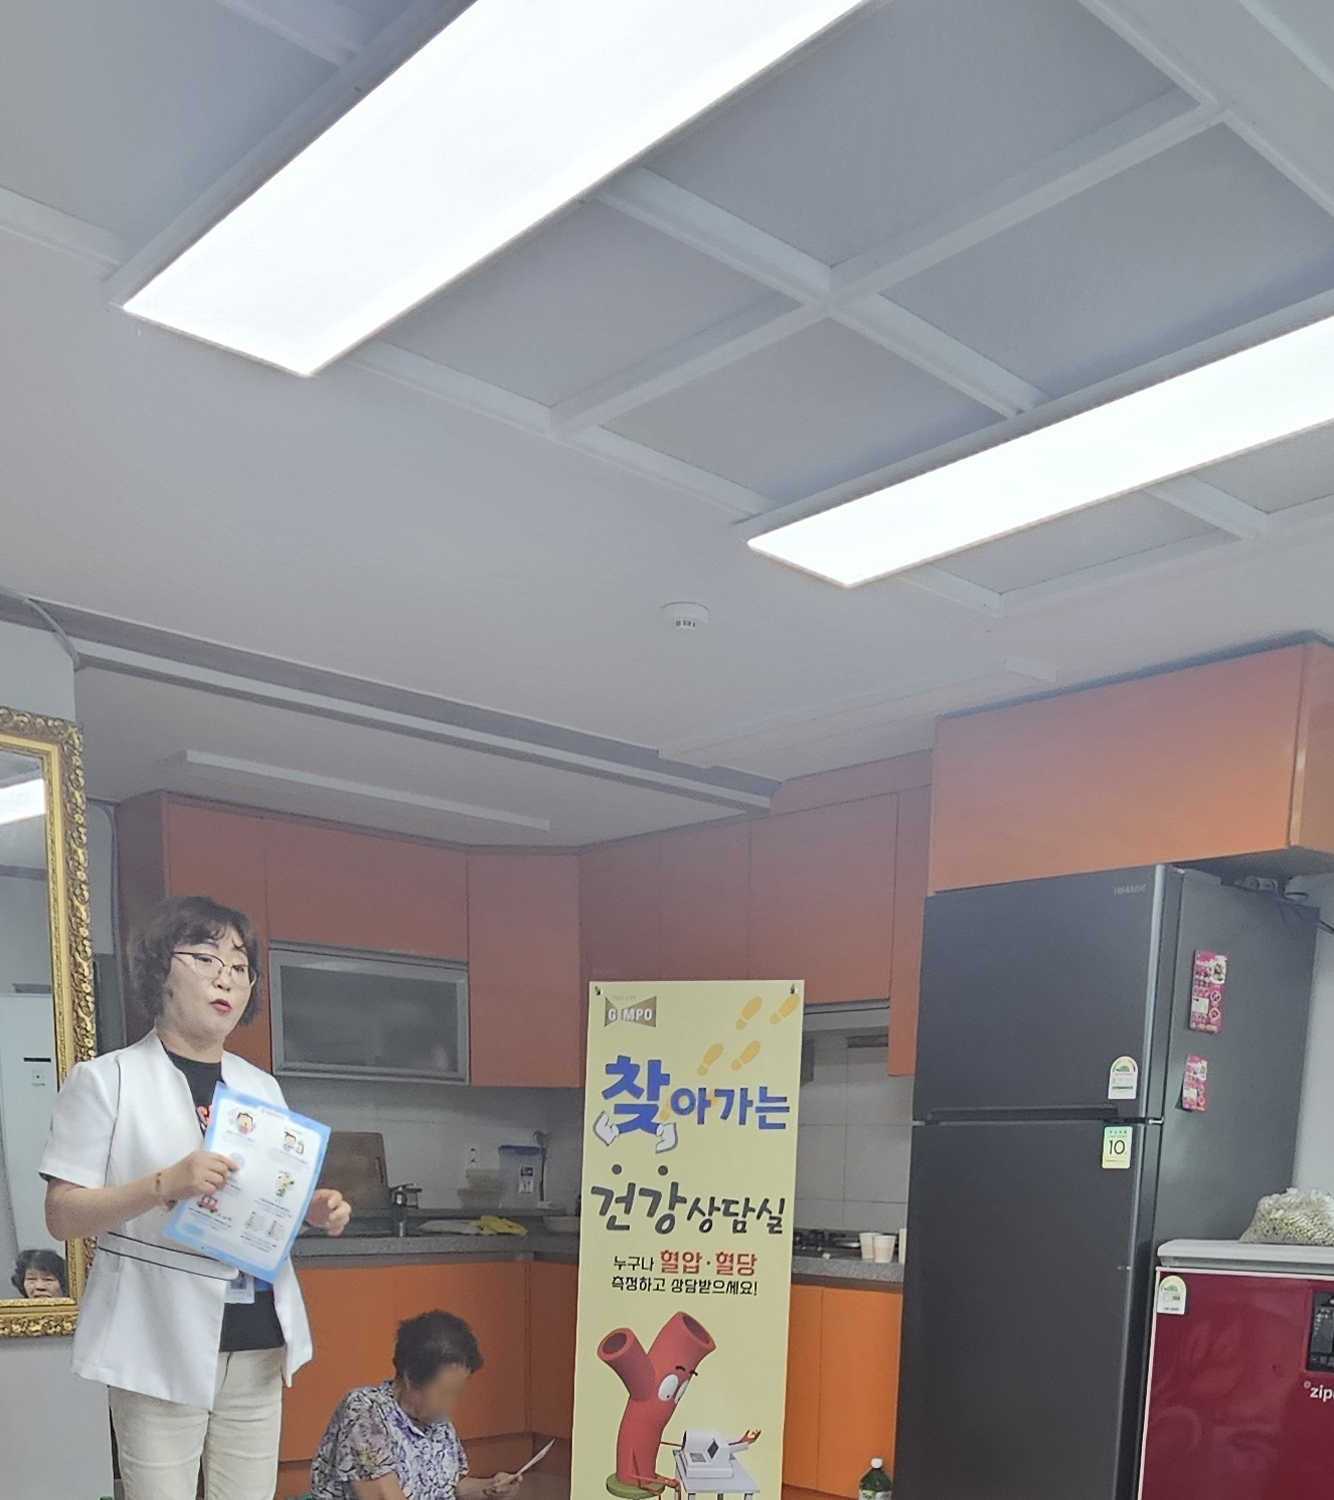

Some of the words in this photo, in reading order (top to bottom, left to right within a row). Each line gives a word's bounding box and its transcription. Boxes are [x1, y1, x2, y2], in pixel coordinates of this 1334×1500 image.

[601, 1055, 790, 1135] 찾아가는
[1109, 1139, 1126, 1155] 10
[613, 1255, 655, 1272] 누구나
[611, 1275, 666, 1292] 측정하고
[670, 1278, 758, 1296] 상담받으세요!
